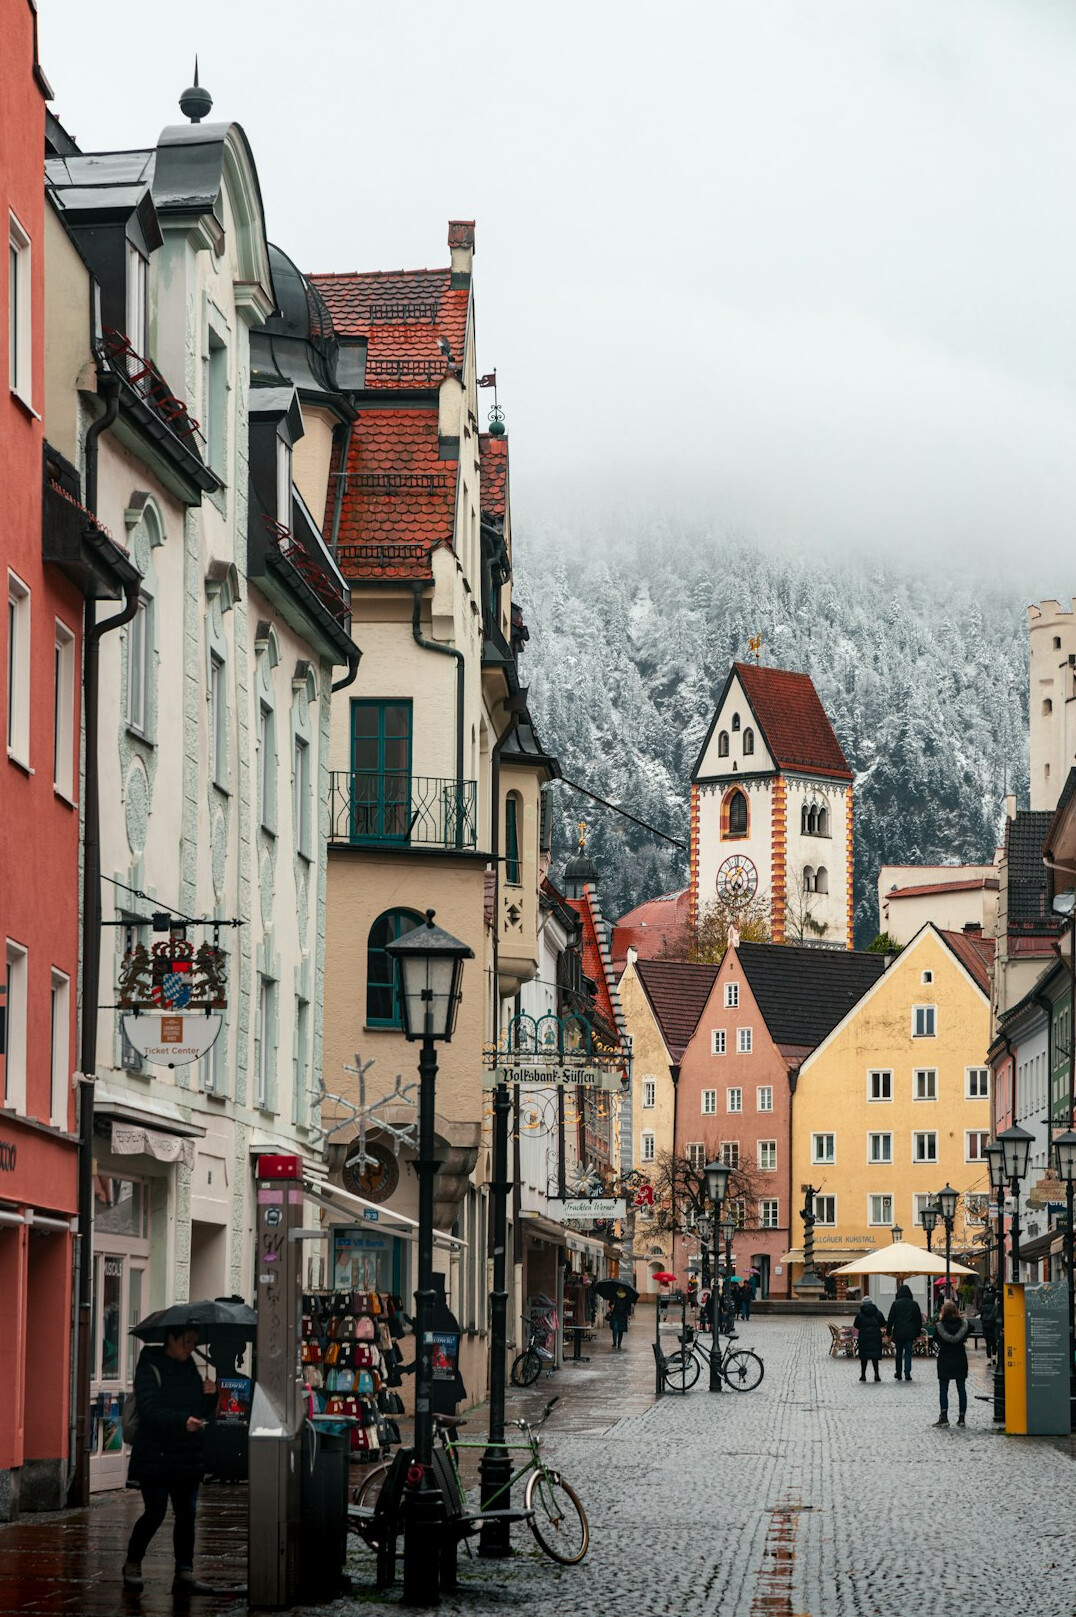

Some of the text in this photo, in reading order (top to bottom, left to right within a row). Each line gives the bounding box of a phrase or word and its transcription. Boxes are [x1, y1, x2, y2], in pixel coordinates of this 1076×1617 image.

[144, 1047, 200, 1055] Ticket Center
[564, 1201, 615, 1212] Trachten Werner
